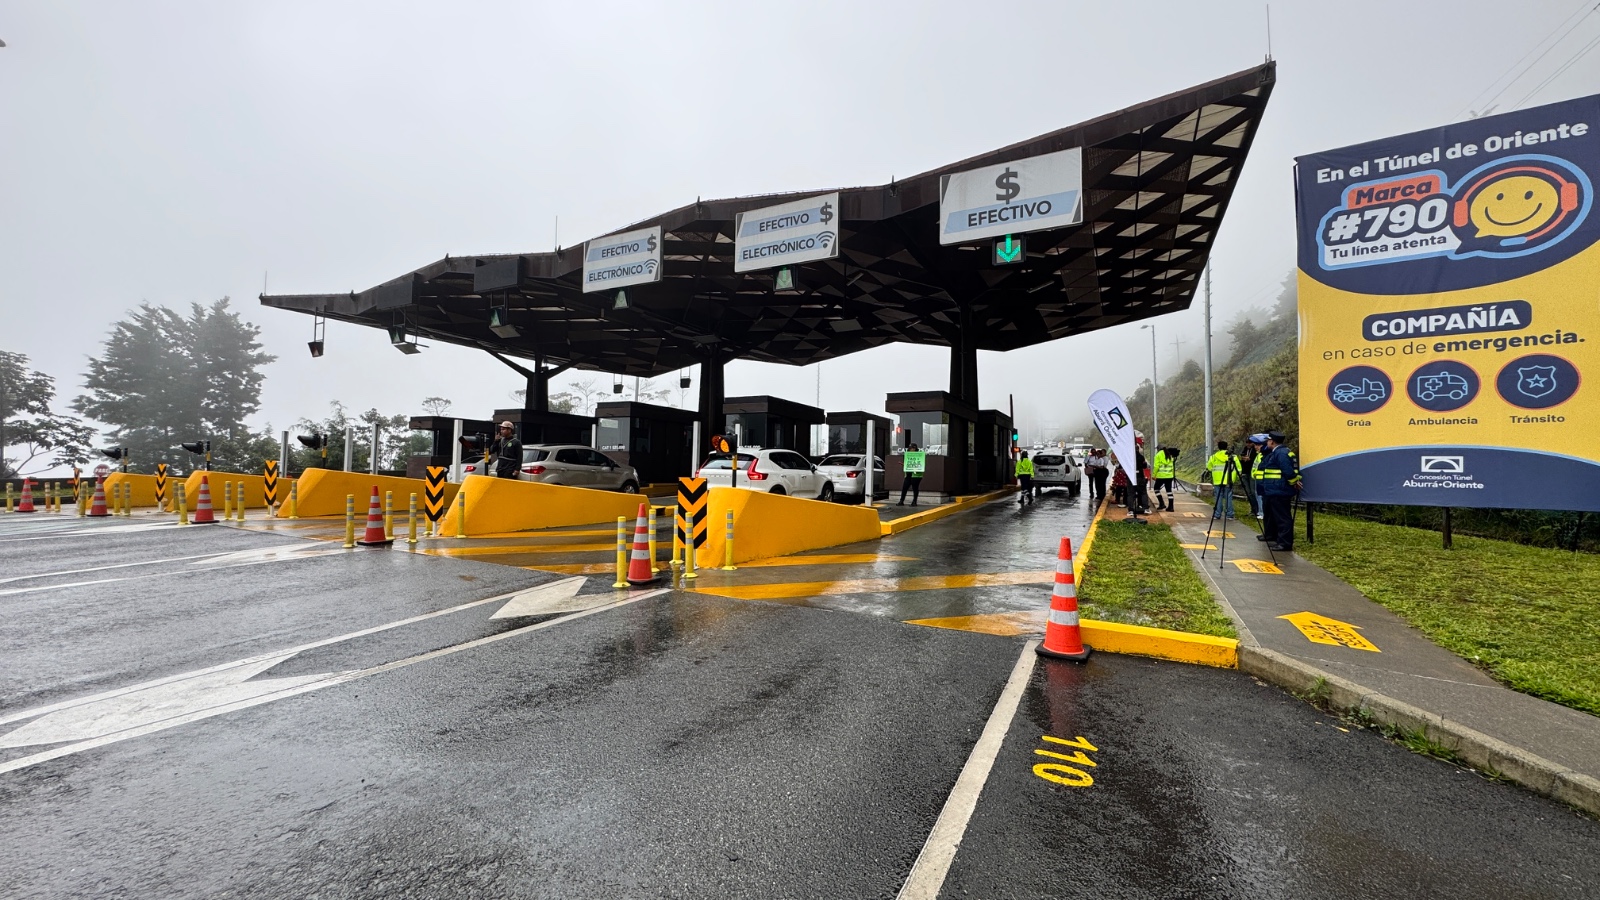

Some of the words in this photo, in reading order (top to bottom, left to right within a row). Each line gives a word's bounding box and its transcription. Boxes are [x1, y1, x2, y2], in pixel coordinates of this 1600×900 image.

[1316, 168, 1344, 184] En
[1349, 160, 1369, 178] el
[1374, 147, 1440, 173] Túnel
[1446, 141, 1478, 160] de
[1483, 121, 1589, 153] Oriente
[1355, 179, 1433, 205] Marca
[759, 213, 810, 232] EFECTIVO
[967, 200, 1052, 227] EFECTIVO
[1328, 198, 1448, 242] #790
[601, 243, 640, 258] EFECTIVO
[742, 238, 815, 260] ELECTRÓNICO
[1330, 248, 1348, 259] Tu
[1351, 242, 1389, 257] línea
[1392, 235, 1447, 251] atenta
[588, 263, 643, 282] ELECTRÓNICO
[1371, 306, 1520, 337] COMPAÑÍA
[1323, 349, 1345, 360] en
[1350, 345, 1396, 358] caso
[1402, 341, 1427, 355] de
[1433, 329, 1586, 352] emergencia.
[1346, 418, 1371, 427] Grúa
[1408, 416, 1478, 426] Ambulancia
[1509, 413, 1565, 424] Tránsito
[1032, 735, 1099, 788] 110
